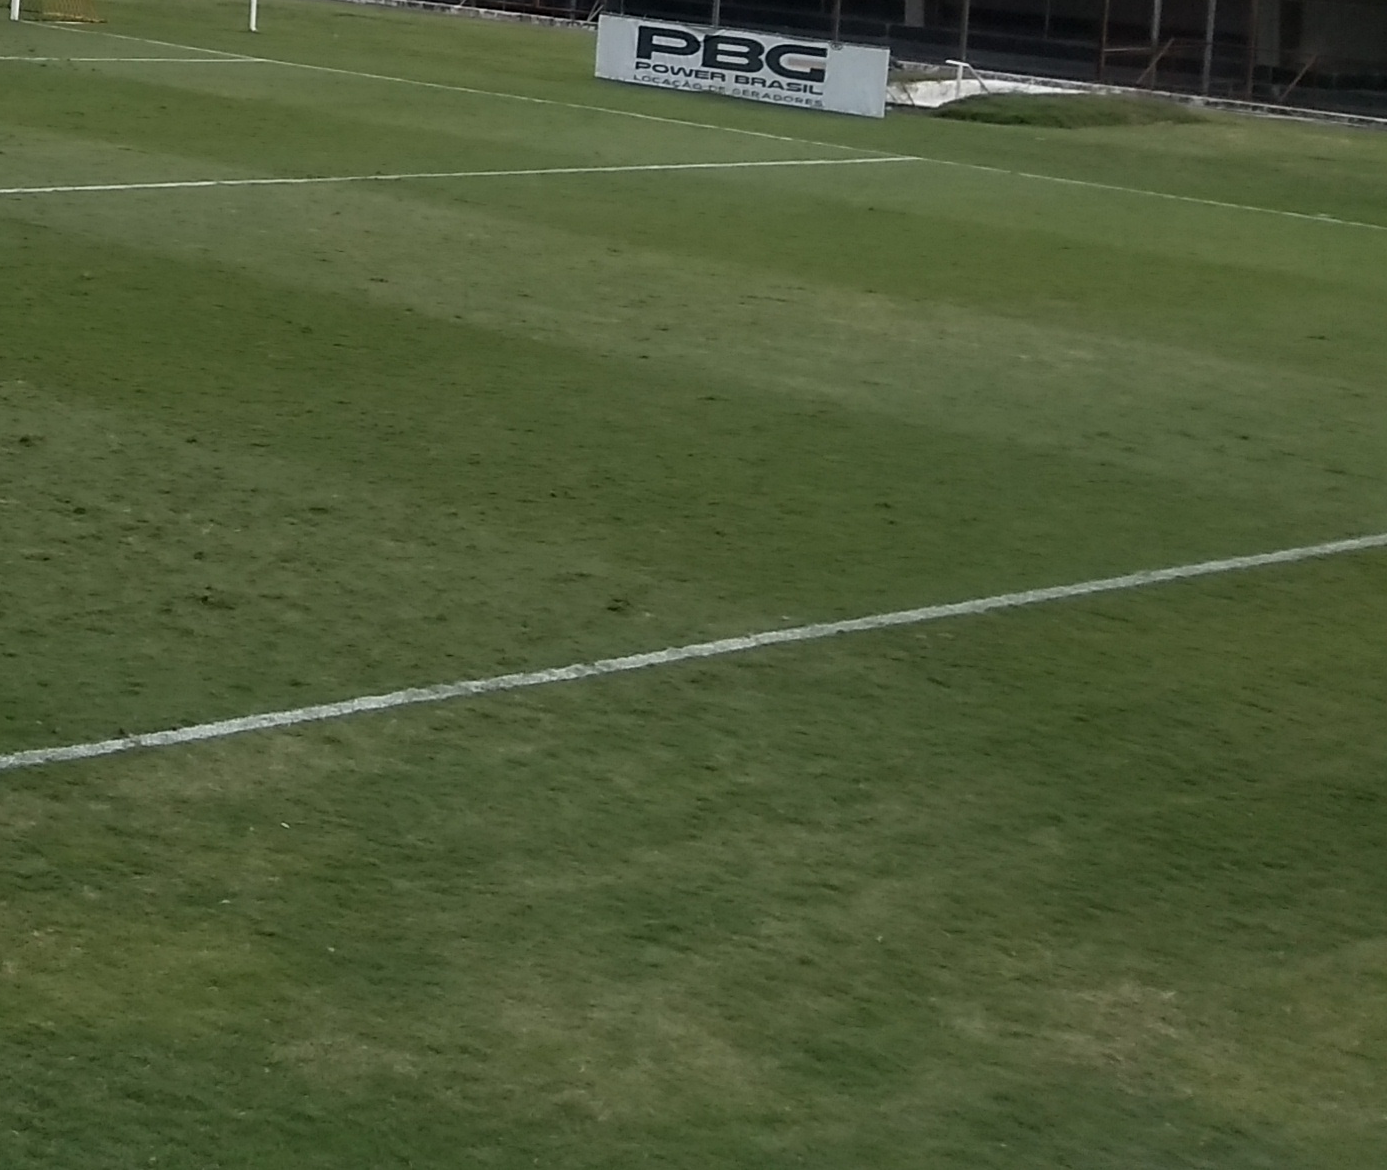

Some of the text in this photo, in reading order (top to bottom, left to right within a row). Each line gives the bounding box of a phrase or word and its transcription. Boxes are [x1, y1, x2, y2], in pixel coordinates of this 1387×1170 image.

[636, 25, 827, 82] PBG
[635, 61, 823, 95] POWER BRASIL
